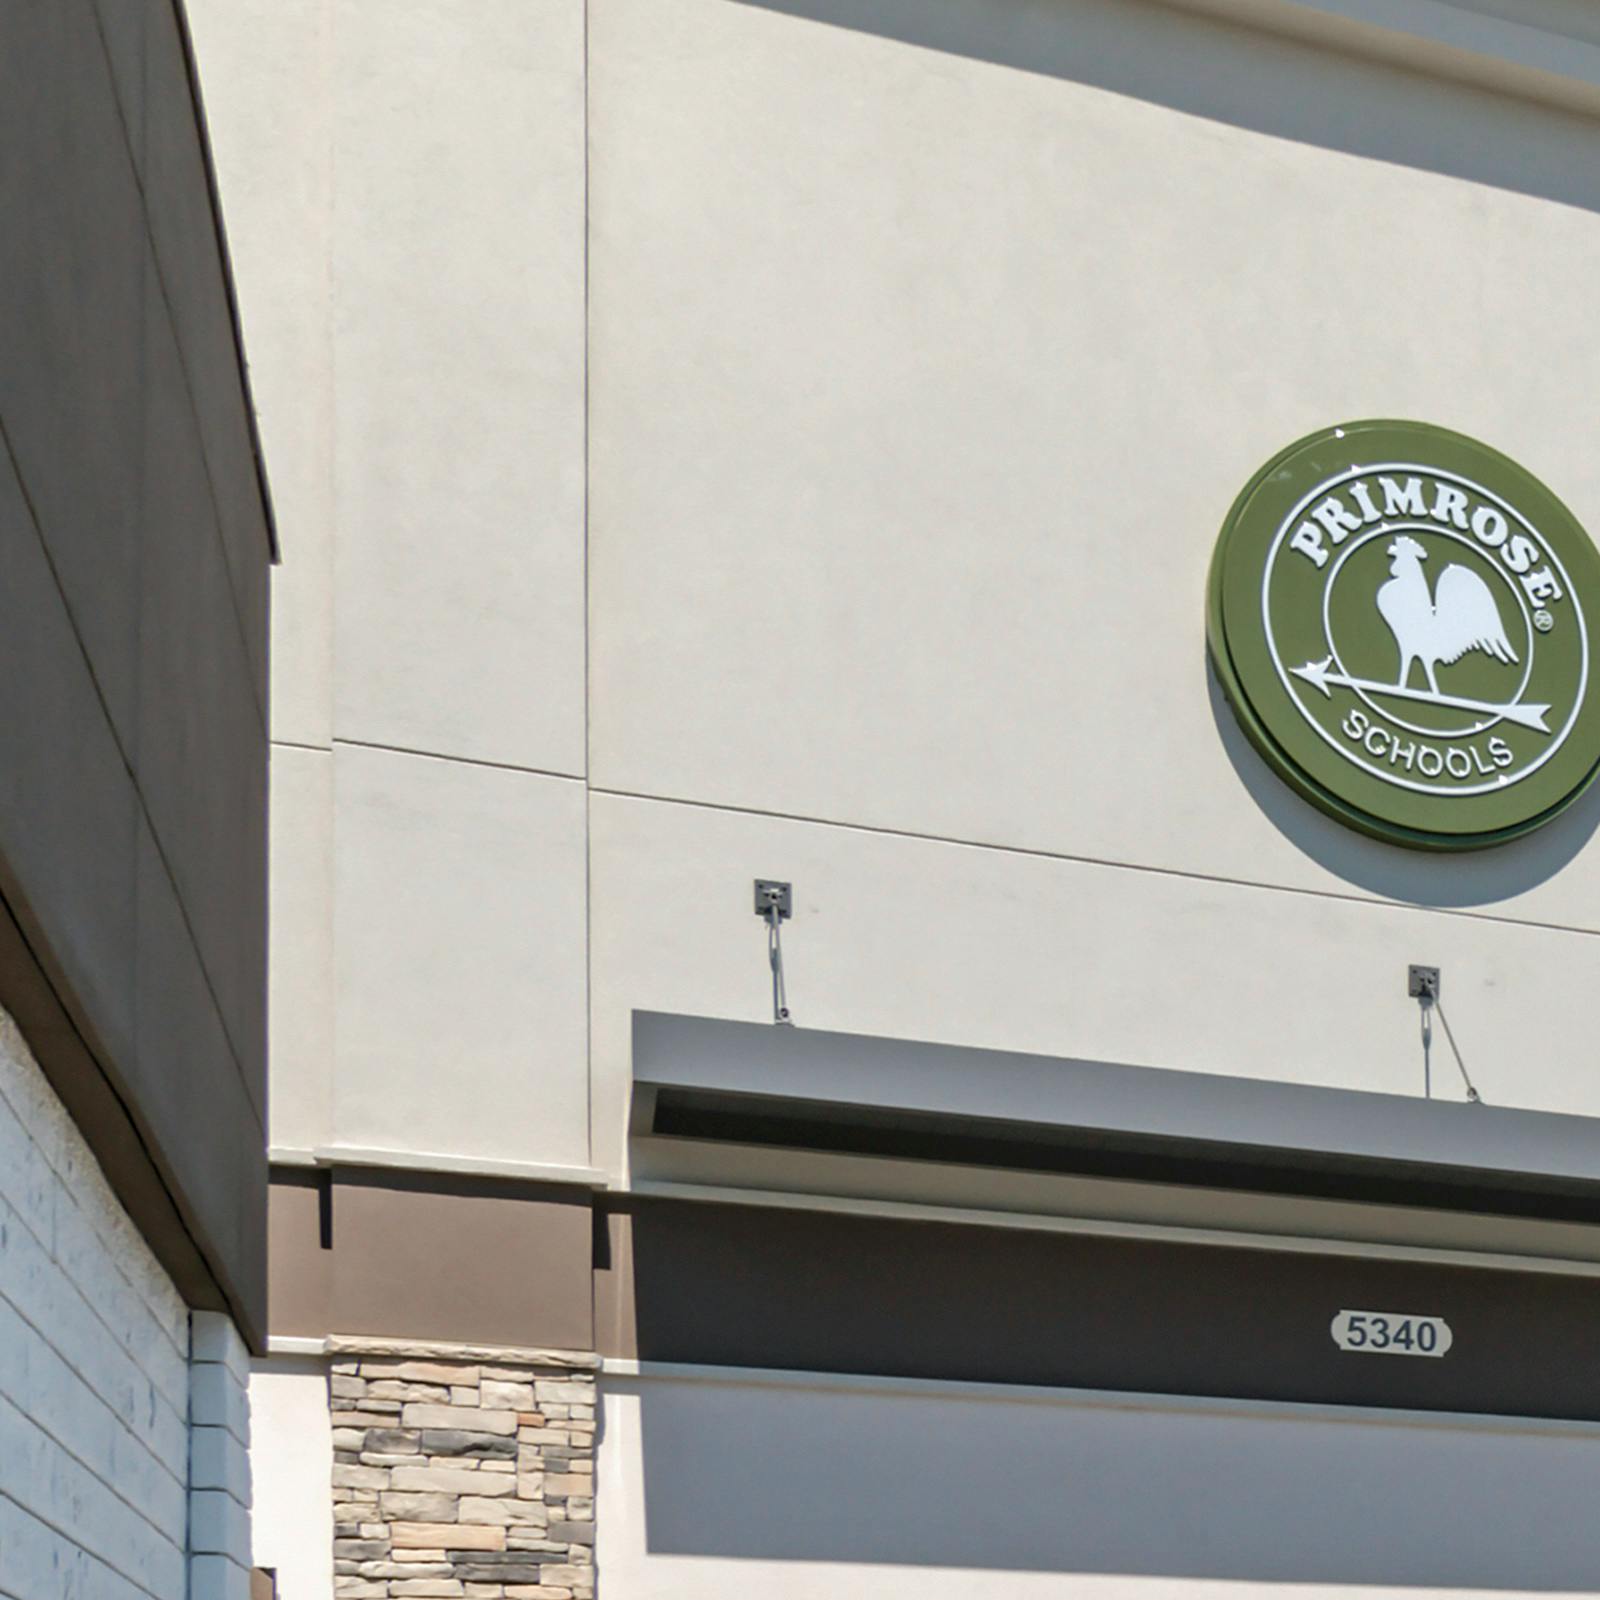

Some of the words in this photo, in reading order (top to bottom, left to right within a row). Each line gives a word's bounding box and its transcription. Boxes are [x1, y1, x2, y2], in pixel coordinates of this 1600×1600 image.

[1290, 477, 1562, 608] PRIMROSE
[1342, 709, 1514, 778] SCHOOLS
[1347, 1316, 1437, 1352] 5340
